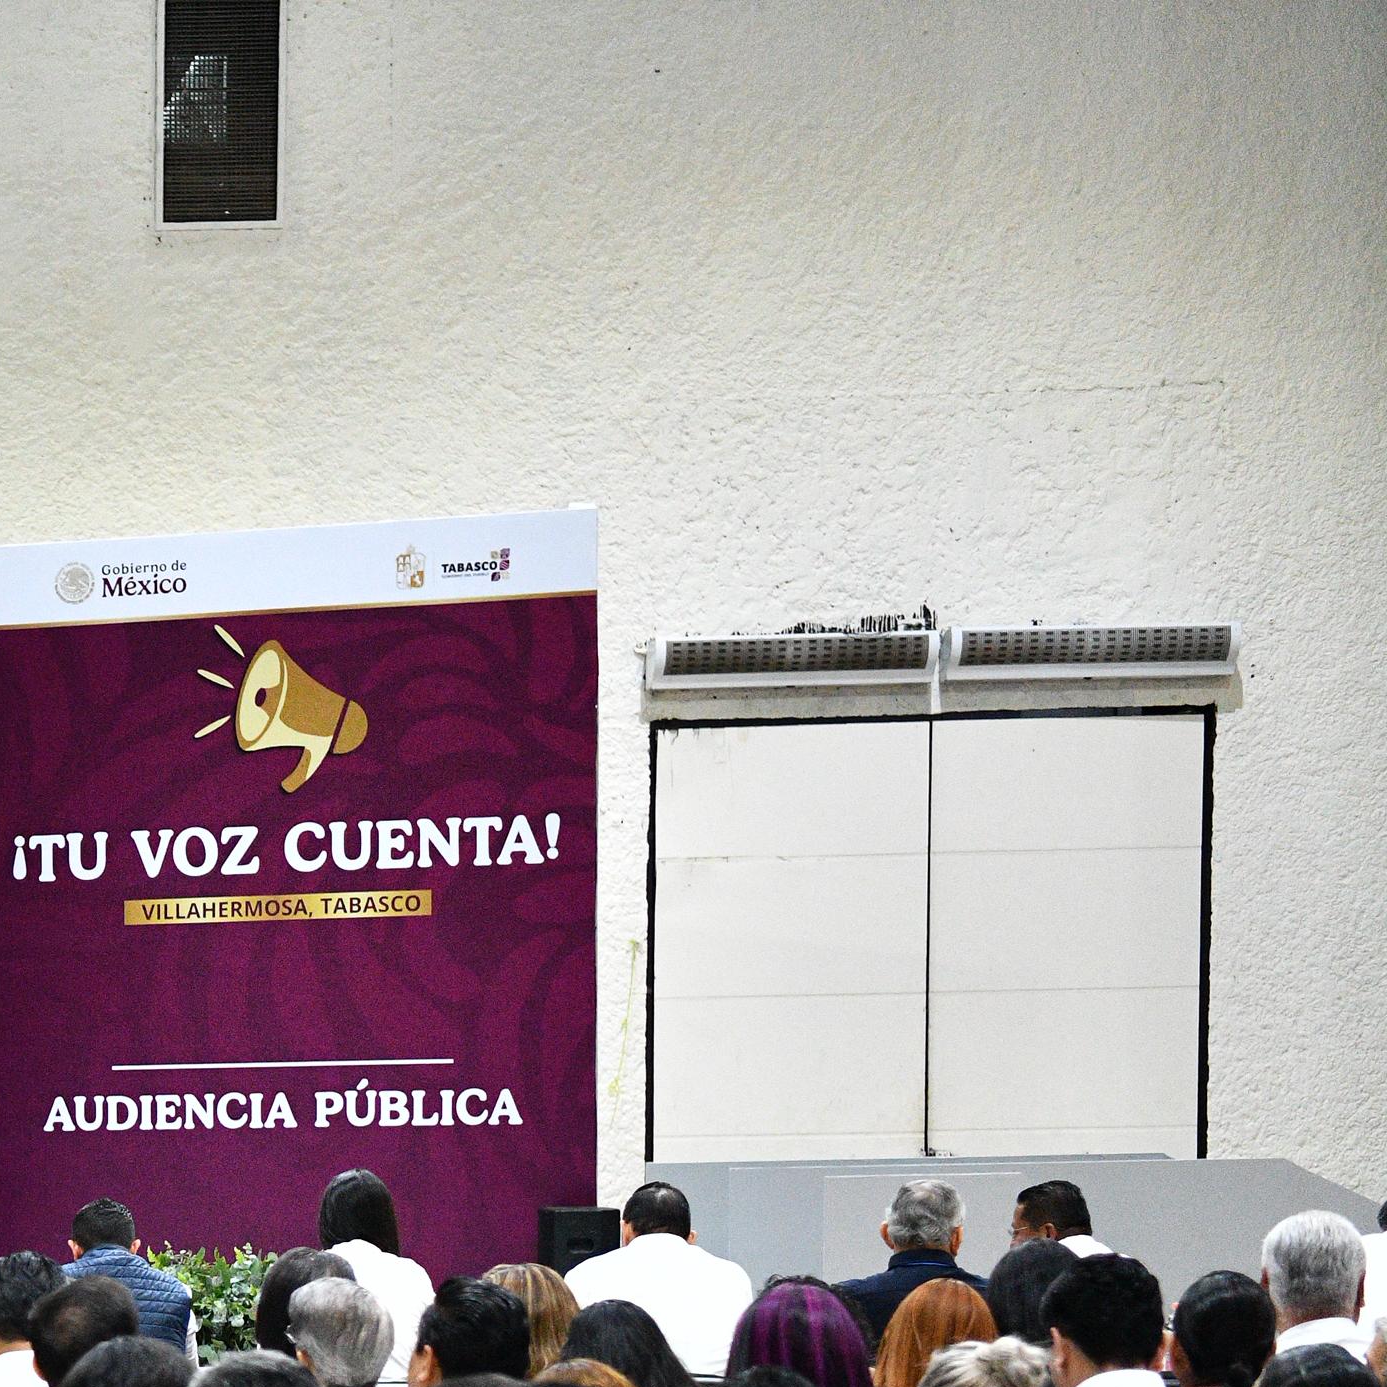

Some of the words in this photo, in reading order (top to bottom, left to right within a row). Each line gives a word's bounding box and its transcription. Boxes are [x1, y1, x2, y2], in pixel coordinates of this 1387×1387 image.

[101, 564, 167, 576] Gobierno
[171, 559, 187, 572] de
[441, 560, 499, 575] TABASCO
[102, 573, 187, 598] México
[12, 831, 109, 883] ¡TU
[130, 825, 260, 879] VOZ
[283, 812, 561, 873] CUENTA!
[141, 898, 315, 921] VILLAHERMOSA,
[320, 894, 422, 915] TABASCO
[43, 1092, 298, 1132] AUDIENCIA
[314, 1078, 524, 1128] PÚBLICA
